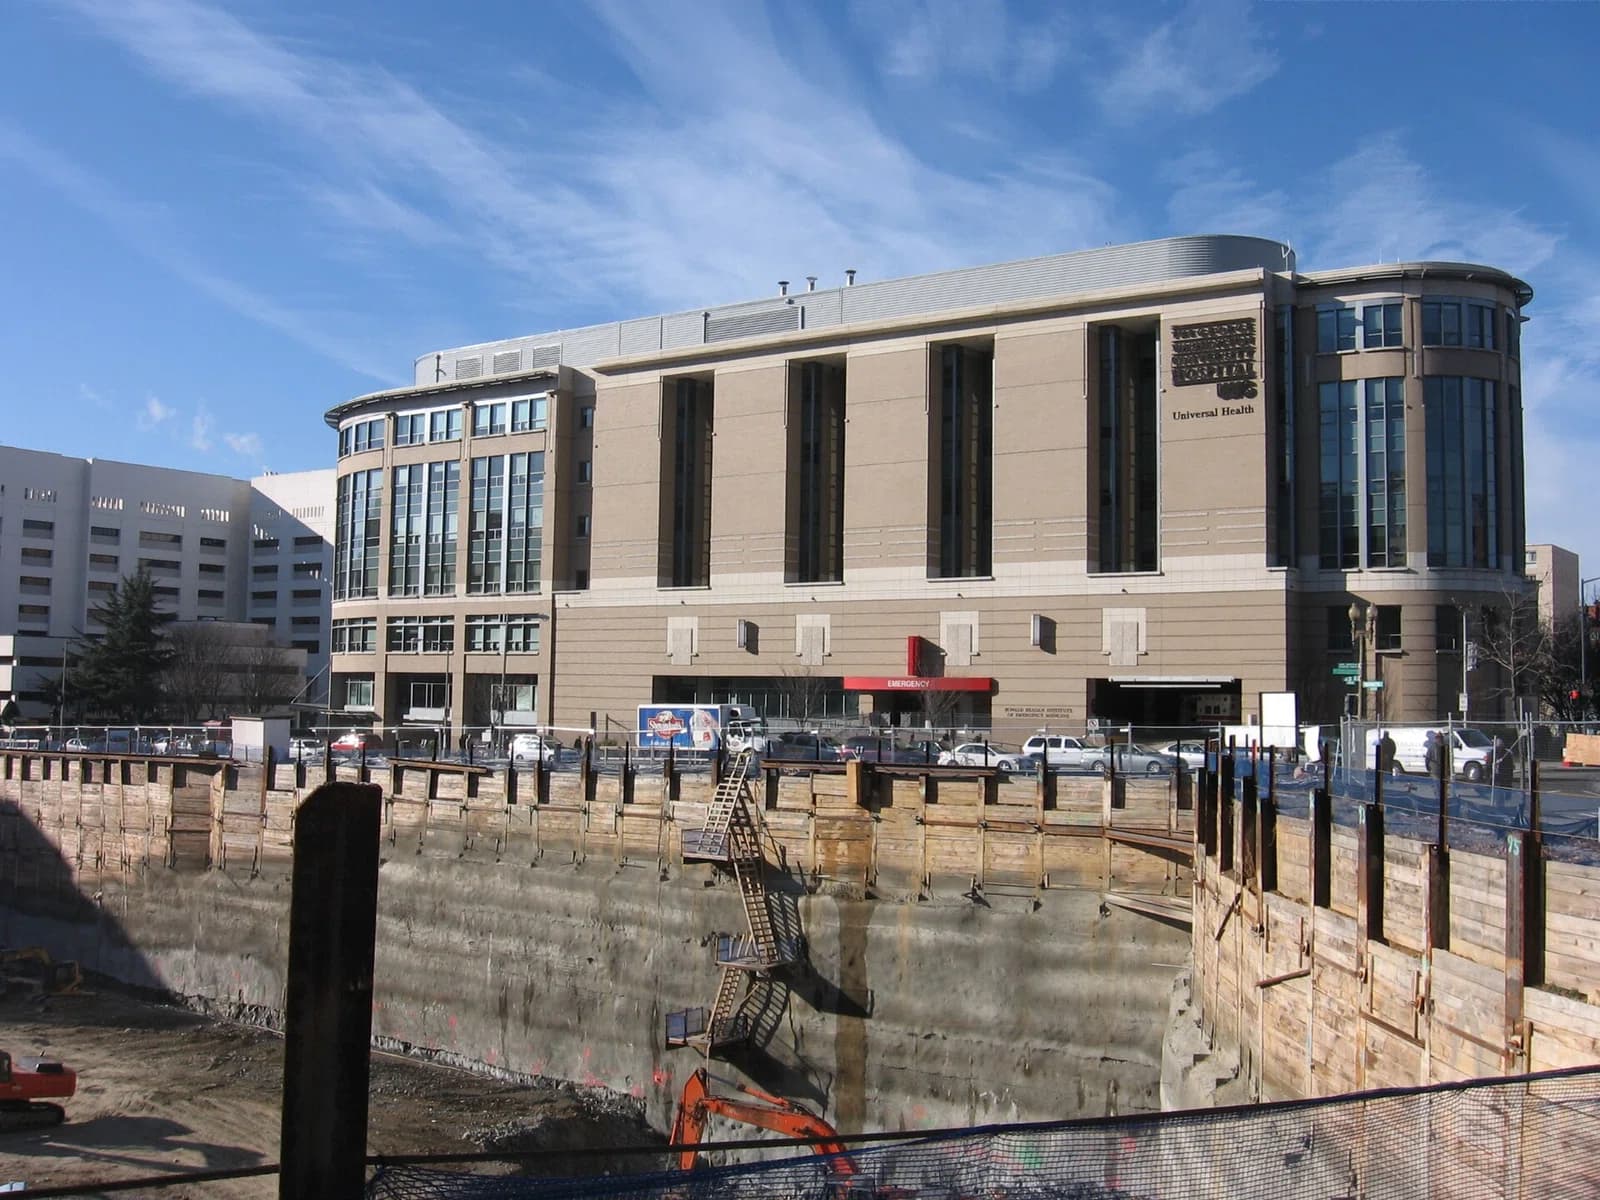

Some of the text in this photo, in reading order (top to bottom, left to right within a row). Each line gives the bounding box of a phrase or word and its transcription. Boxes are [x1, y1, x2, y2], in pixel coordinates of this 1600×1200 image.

[1172, 405, 1254, 420] Universal Health
[887, 680, 930, 688] EMERGENCY
